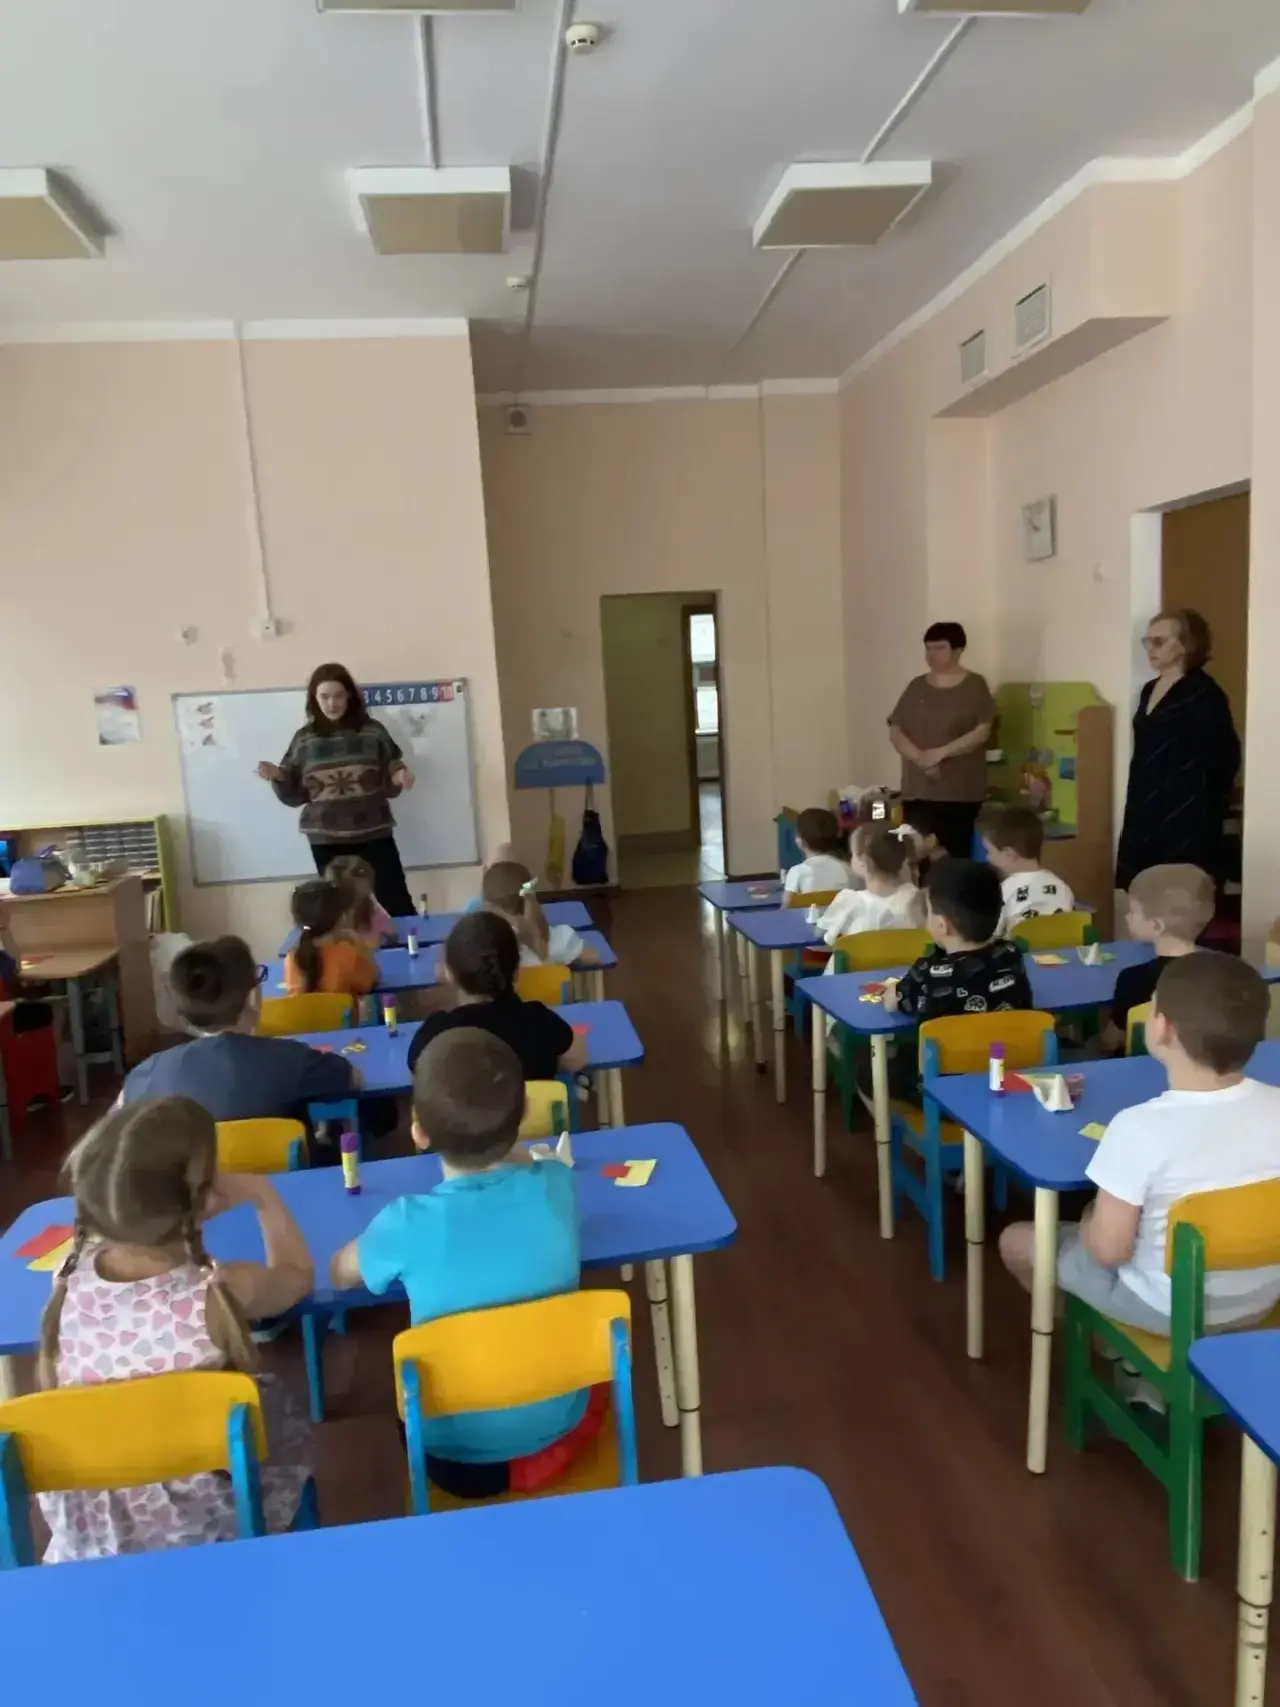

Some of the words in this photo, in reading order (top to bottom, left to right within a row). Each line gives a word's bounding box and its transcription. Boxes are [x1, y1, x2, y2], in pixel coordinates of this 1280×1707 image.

[374, 690, 381, 702] 4
[386, 689, 393, 703] 5
[397, 688, 404, 702] 6
[408, 688, 415, 701] 7
[420, 687, 427, 701] 8
[431, 686, 438, 700] 9
[441, 686, 452, 699] 10
